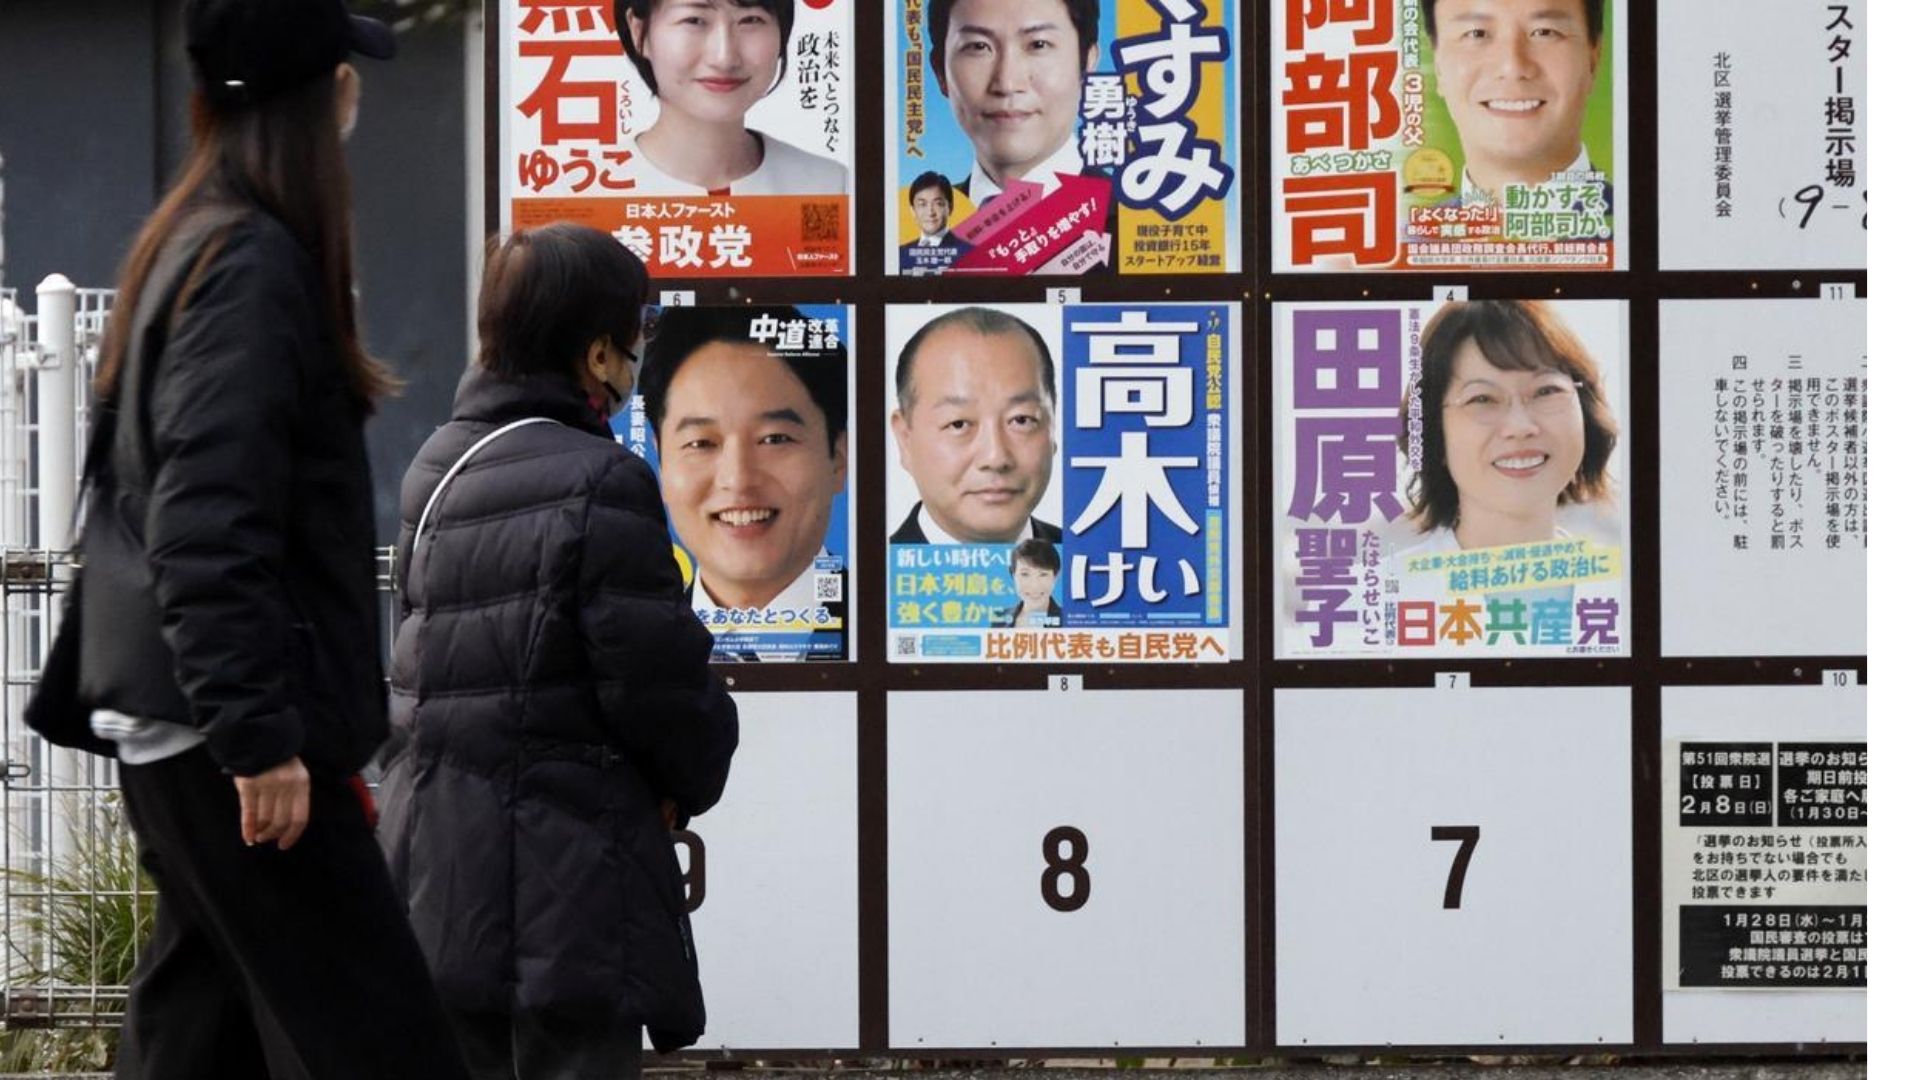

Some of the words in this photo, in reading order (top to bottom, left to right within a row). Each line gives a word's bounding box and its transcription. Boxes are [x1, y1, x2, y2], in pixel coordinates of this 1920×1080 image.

[797, 33, 820, 110] 政治を
[1714, 52, 1731, 87] 北区
[823, 31, 840, 152] 未来へとつなぐ
[619, 79, 632, 135] くろいし
[1082, 75, 1127, 166] 勇樹
[1292, 157, 1332, 174] あべ
[1334, 151, 1392, 171] つかさ
[1714, 91, 1732, 218] 選挙管理委員会
[518, 148, 636, 192] ゆうこ
[626, 203, 736, 219] 日本人ファースト
[1505, 184, 1608, 211] 動かすぞ、
[1136, 224, 1208, 238] 現役子育て中
[1505, 212, 1612, 239] 阿部司が。
[1133, 240, 1211, 252] 投資銀行15年
[674, 292, 683, 306] 6
[1058, 290, 1067, 304] 5
[1447, 290, 1455, 301] 4
[1829, 287, 1843, 300] 11
[749, 313, 807, 350] 中道
[1732, 355, 1748, 370] 四
[1788, 356, 1803, 370] 三
[1751, 378, 1768, 460] せられます。
[1807, 377, 1822, 474] 用できません。
[1714, 378, 1731, 520] 車しないでください。
[1770, 378, 1786, 549] ターを破ったりすると罰
[1825, 378, 1841, 549] このポスター掲示場を使
[1070, 552, 1201, 607] けい
[1361, 529, 1381, 645] たはらせいこ
[1449, 555, 1610, 591] 給料あげる政治に
[1397, 598, 1620, 647] 日本共産党
[985, 631, 1225, 660] 比例代表も自民党へ
[1059, 678, 1069, 692] 8
[1449, 675, 1457, 689] 7
[1832, 672, 1847, 687] 10
[1040, 826, 1092, 912] 8
[1430, 826, 1481, 909] 7
[1693, 851, 1848, 865] をお持ちでない場合でも
[1692, 869, 1867, 883] 北区の選挙人の要件を満た
[1692, 886, 1776, 899] 投票できます
[1750, 930, 1867, 945] 国民審査の投票は
[1720, 965, 1867, 979] 投票できるのは2月1
